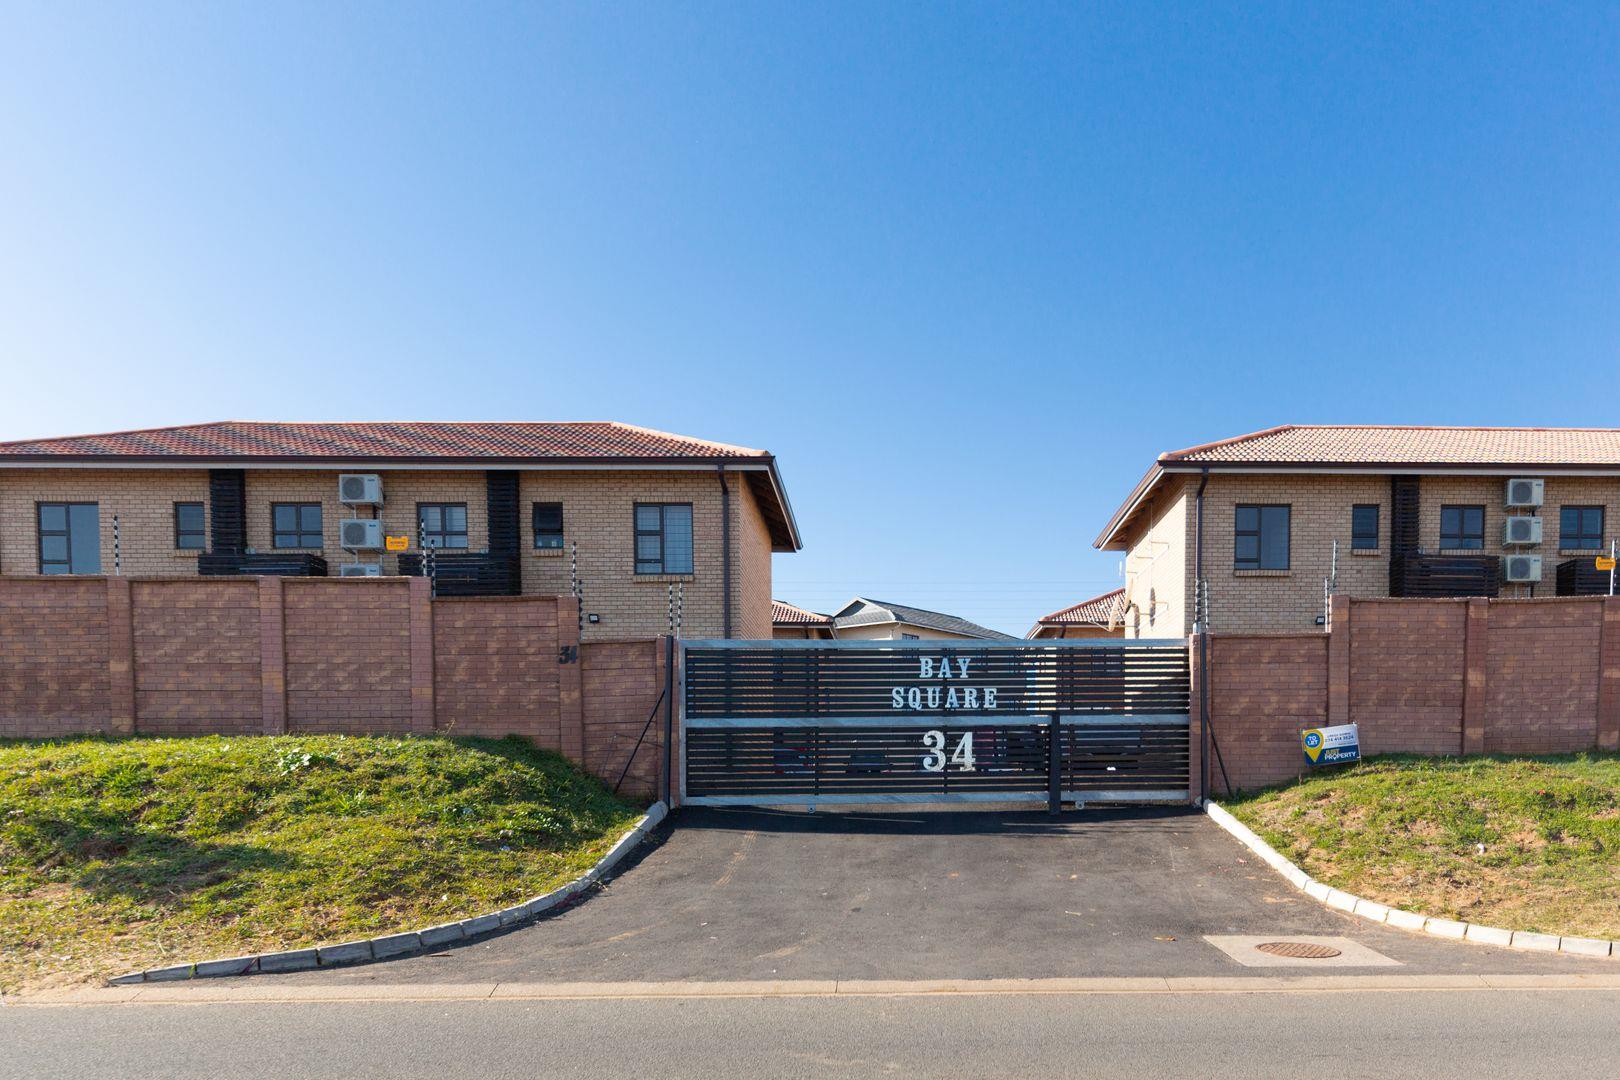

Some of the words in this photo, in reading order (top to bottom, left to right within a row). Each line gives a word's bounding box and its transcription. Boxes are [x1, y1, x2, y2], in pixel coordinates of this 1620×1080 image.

[559, 645, 578, 664] 34
[919, 657, 971, 678] BAY
[892, 687, 997, 710] SQUARE
[923, 730, 976, 772] 34
[1324, 751, 1356, 760] PROPERTY
